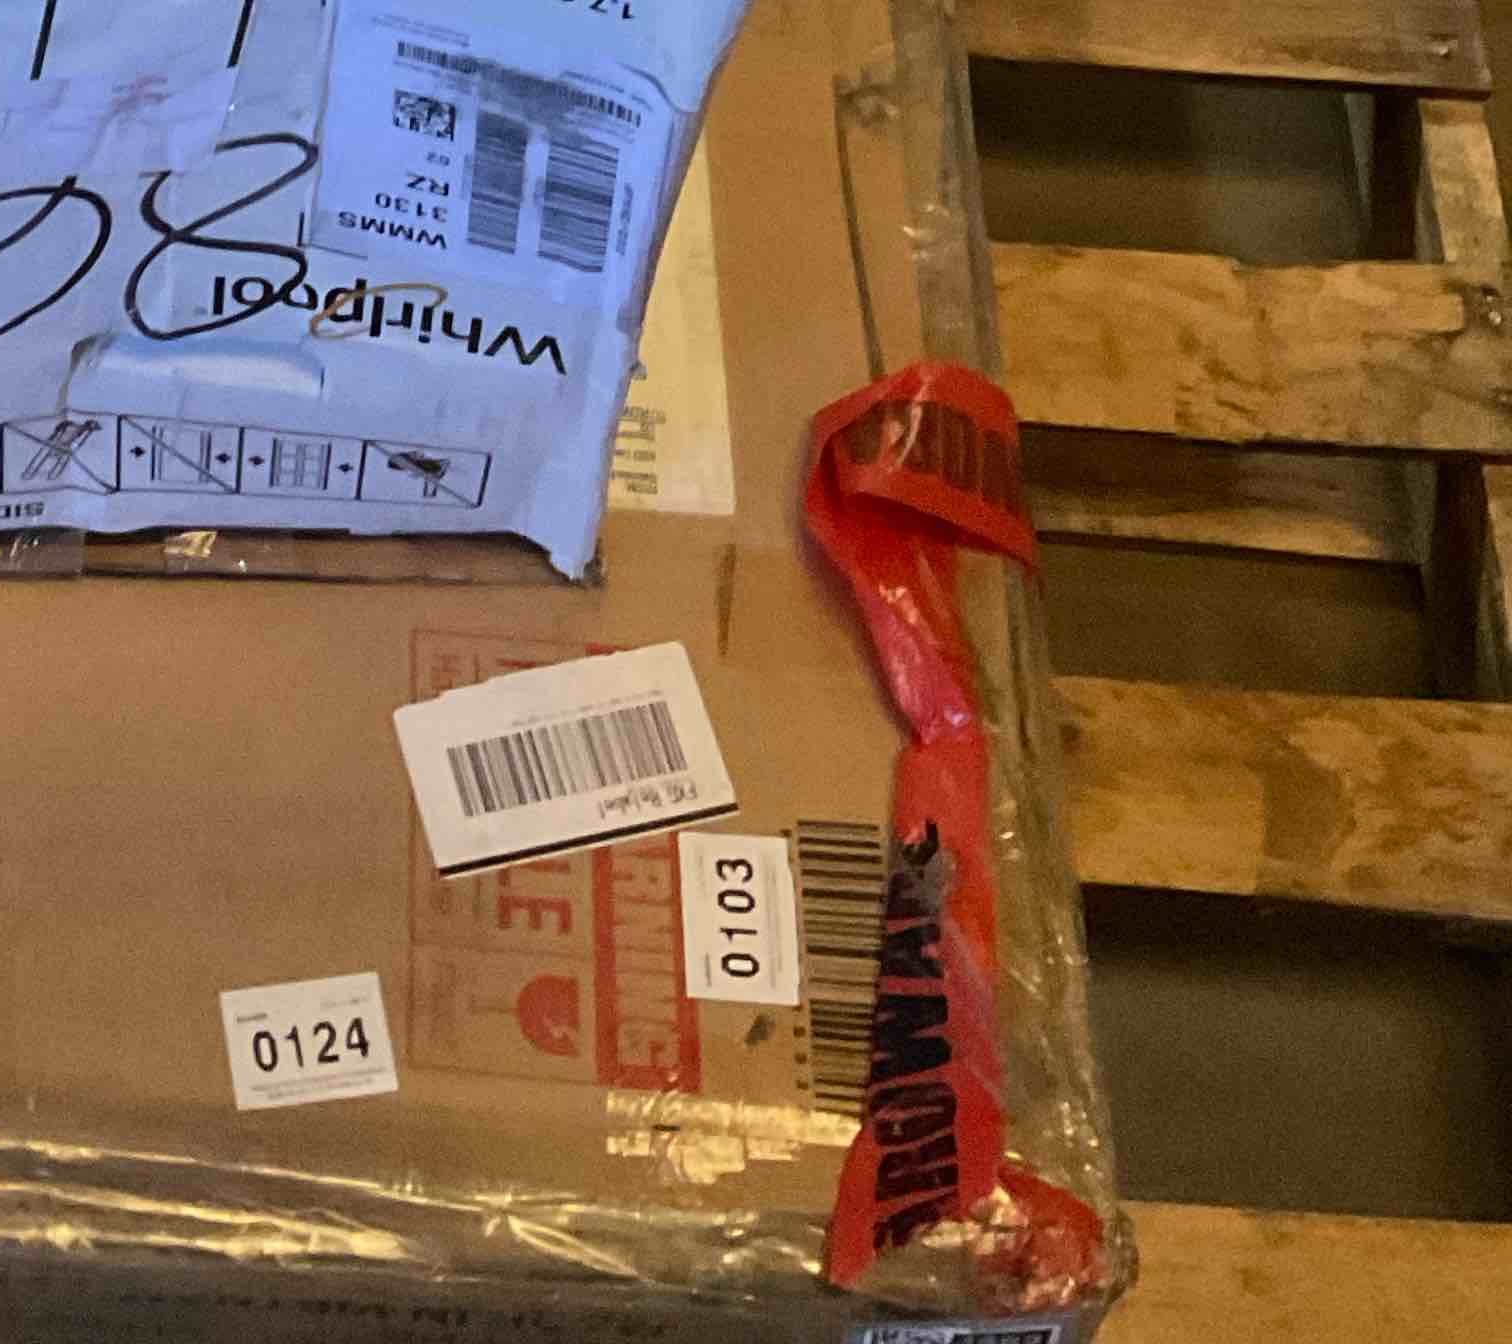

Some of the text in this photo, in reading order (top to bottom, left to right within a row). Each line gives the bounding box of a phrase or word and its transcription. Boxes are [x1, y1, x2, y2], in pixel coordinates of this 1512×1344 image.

[374, 192, 448, 224] 3130
[404, 174, 451, 197] RZ
[336, 210, 448, 251] WMMS
[211, 275, 568, 377] Whirlpool
[715, 855, 762, 980] 0103
[251, 1016, 372, 1075] 0124
